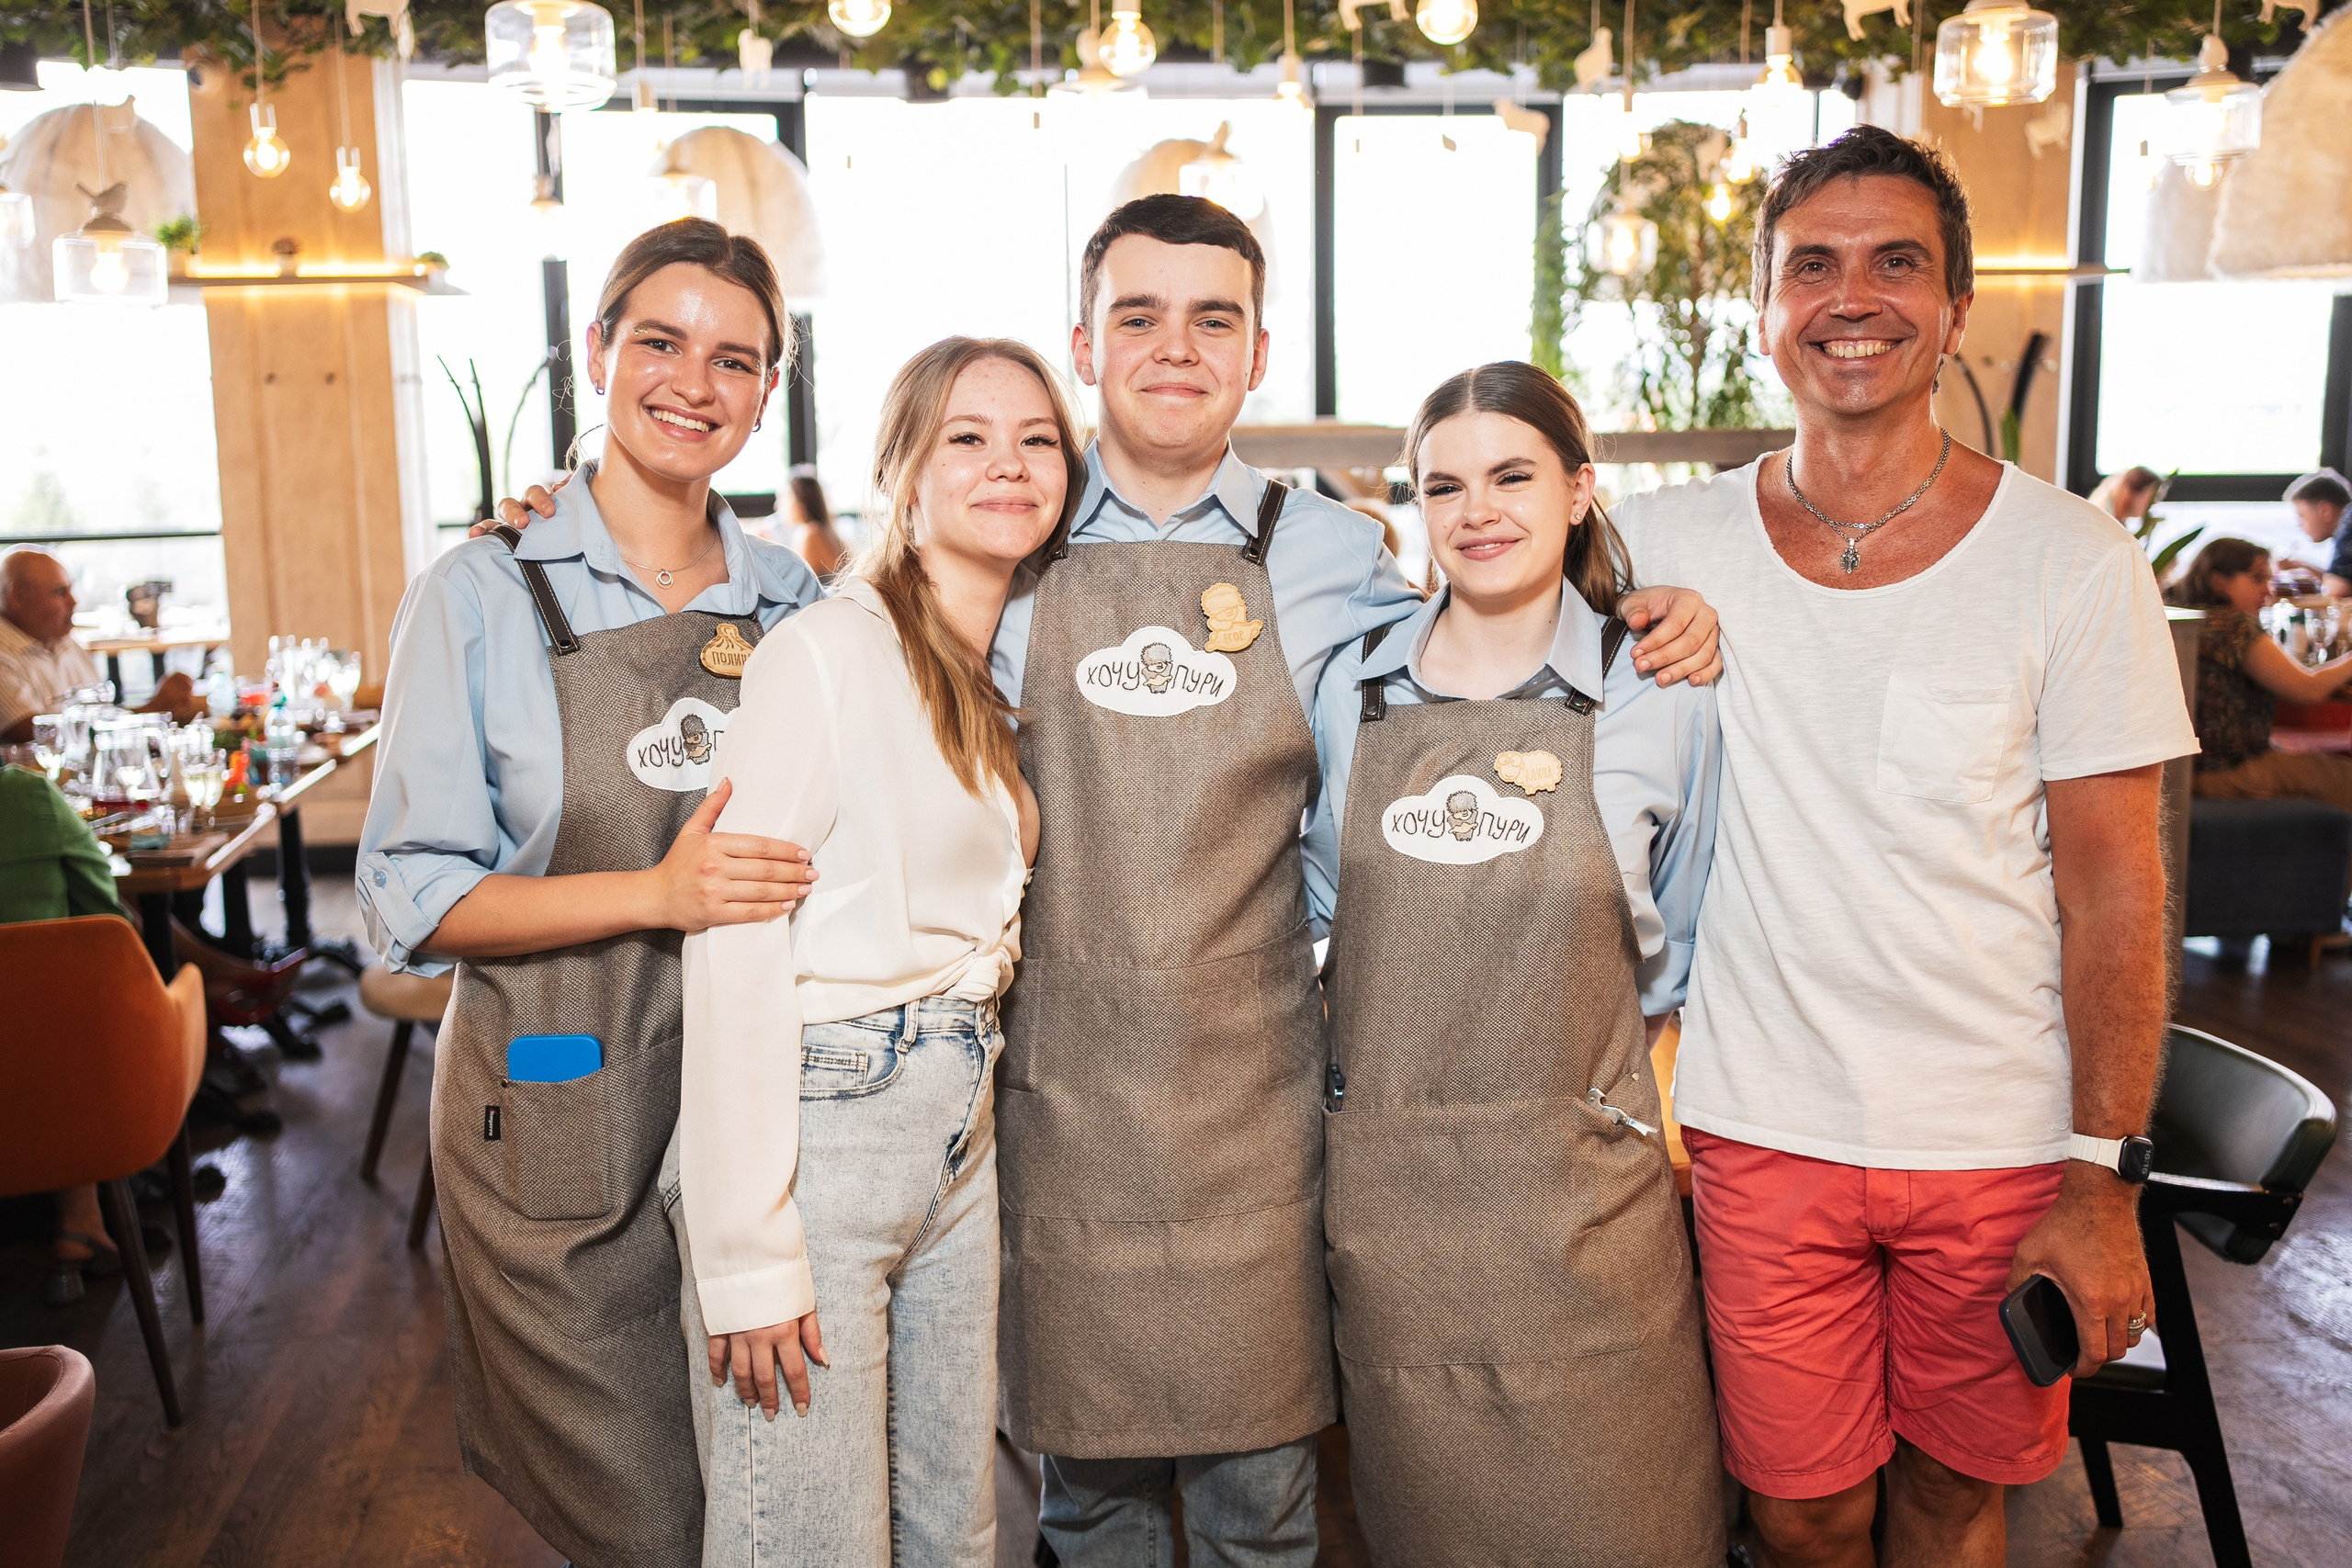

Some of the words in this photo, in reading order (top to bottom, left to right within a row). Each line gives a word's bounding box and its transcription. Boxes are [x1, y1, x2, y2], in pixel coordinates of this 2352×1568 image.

[1224, 631, 1243, 643] ЕГОР
[712, 651, 751, 666] ПОЛИН
[1087, 661, 1140, 691] ХОЧУ
[1171, 664, 1225, 697] ПУРИ
[638, 735, 684, 768] ХОЧУ
[1526, 765, 1553, 782] АЛИНА
[1392, 809, 1445, 839] ХОЧУ
[1476, 811, 1531, 843] ПУРИ
[2142, 1148, 2152, 1175] 16:15
